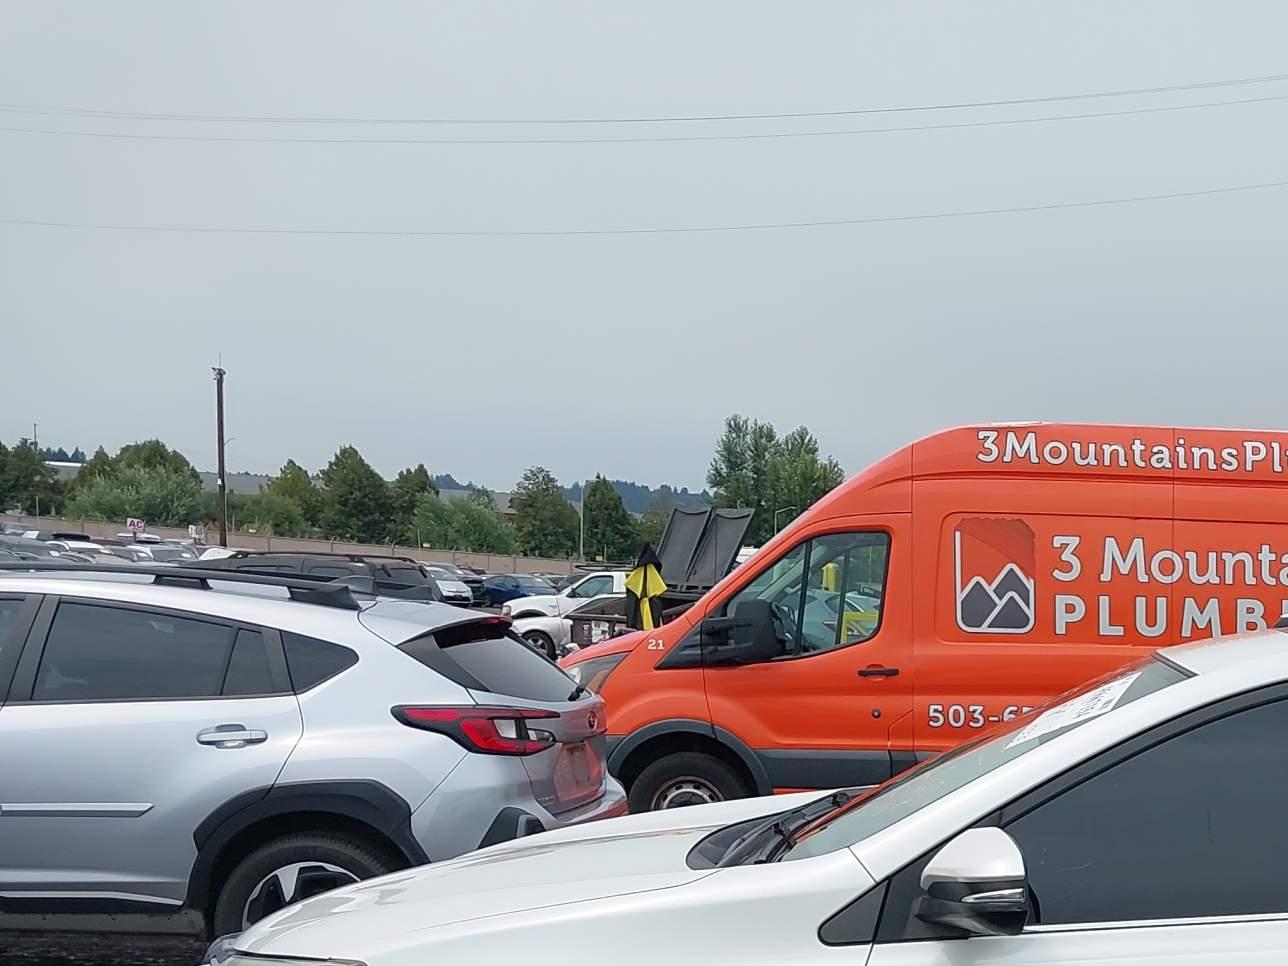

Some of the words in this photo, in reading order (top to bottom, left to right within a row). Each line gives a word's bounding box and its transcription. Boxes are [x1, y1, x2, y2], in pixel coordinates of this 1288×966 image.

[128, 519, 143, 529] AC
[1051, 535, 1082, 582] 3
[647, 639, 665, 650] 21
